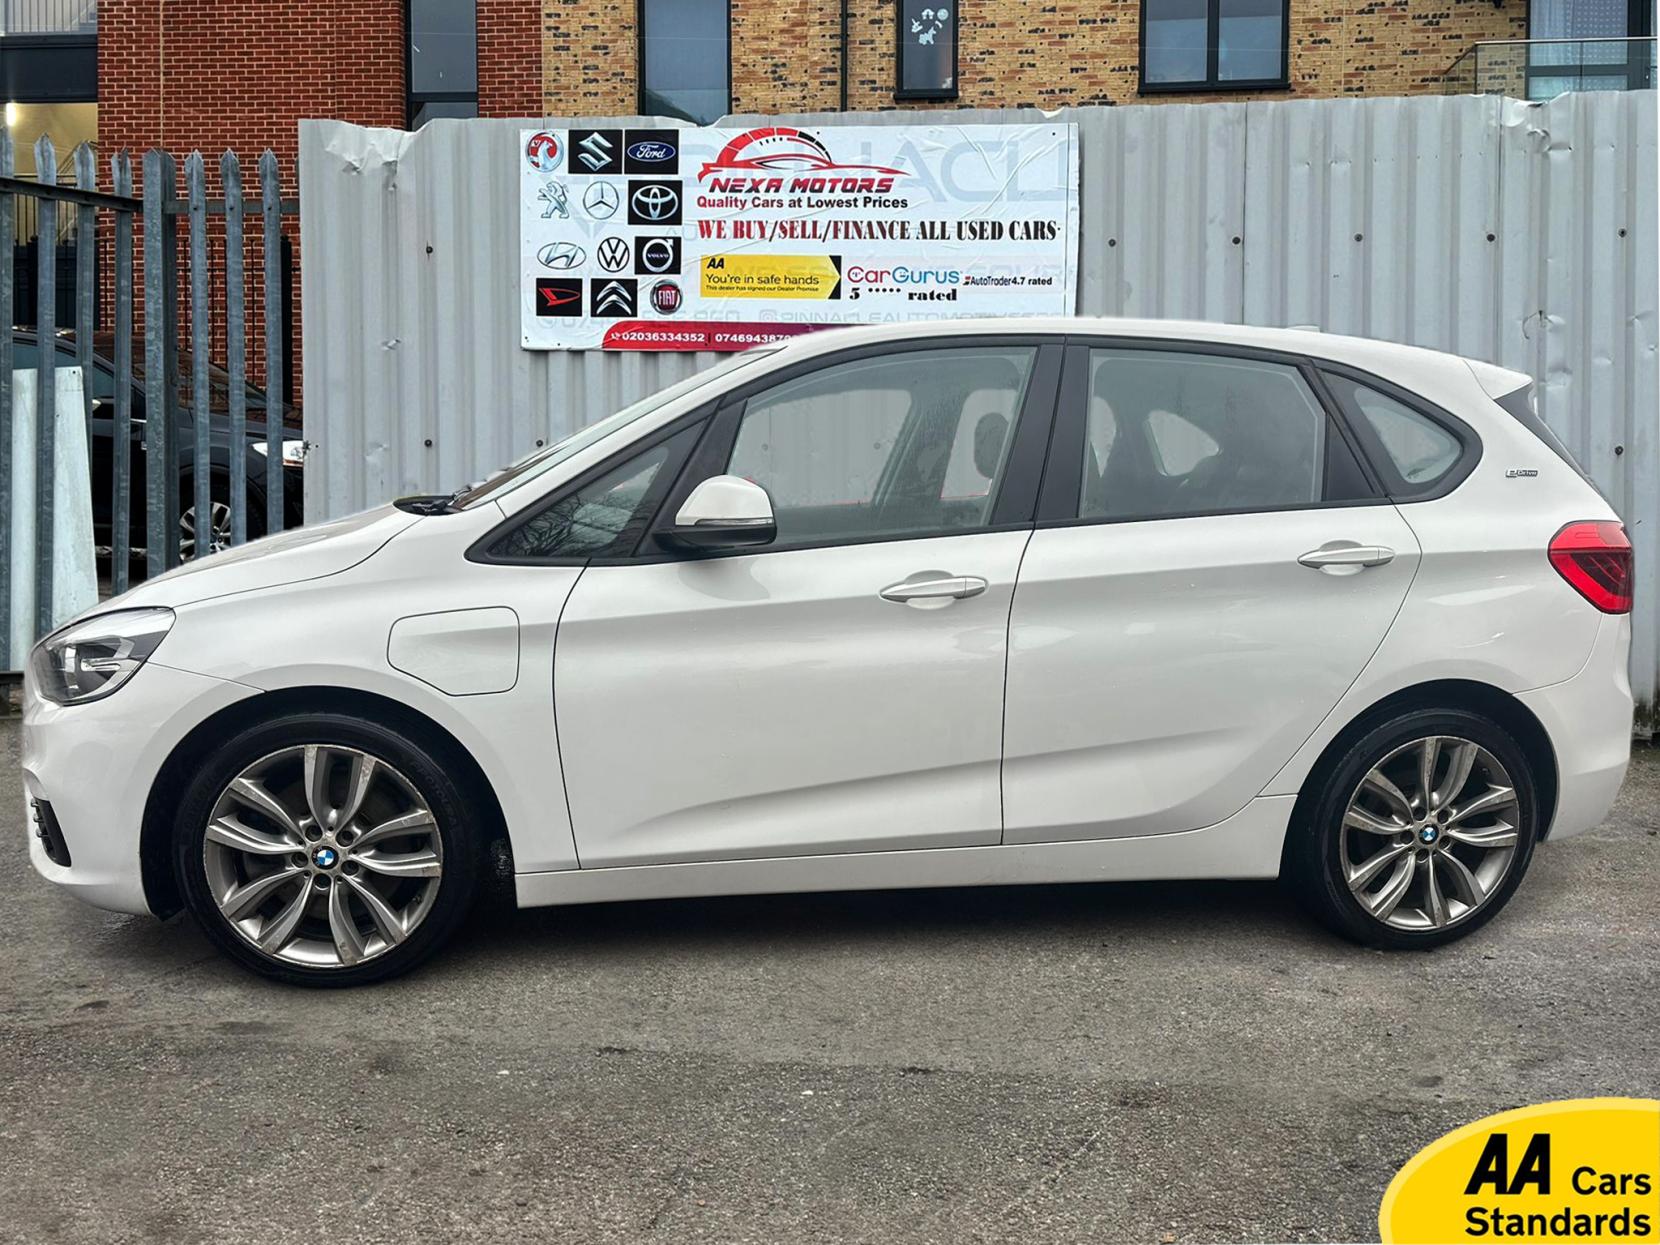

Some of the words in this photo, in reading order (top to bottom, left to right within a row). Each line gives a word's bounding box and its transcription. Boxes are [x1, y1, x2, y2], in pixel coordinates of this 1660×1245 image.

[636, 144, 666, 159] Ford
[709, 178, 784, 193] NEXA
[789, 177, 894, 193] MOTORS
[697, 196, 747, 210] Quality
[752, 196, 784, 208] Cars
[788, 197, 802, 208] at
[807, 196, 859, 208] Lowest
[863, 196, 908, 208] Prices
[697, 220, 727, 239] WE
[916, 220, 951, 240] ALL
[956, 220, 1004, 240] USED
[1009, 220, 1057, 240] CARS
[707, 257, 724, 269] AA
[706, 273, 741, 284] You're
[744, 274, 754, 284] in
[757, 274, 781, 285] safe
[784, 275, 819, 285] hands
[847, 266, 960, 284] CarGurus
[1028, 277, 1052, 286] rated
[658, 290, 676, 306] FIAT
[849, 287, 860, 300] 5
[908, 288, 957, 301] rated
[622, 333, 705, 342] 02036334352
